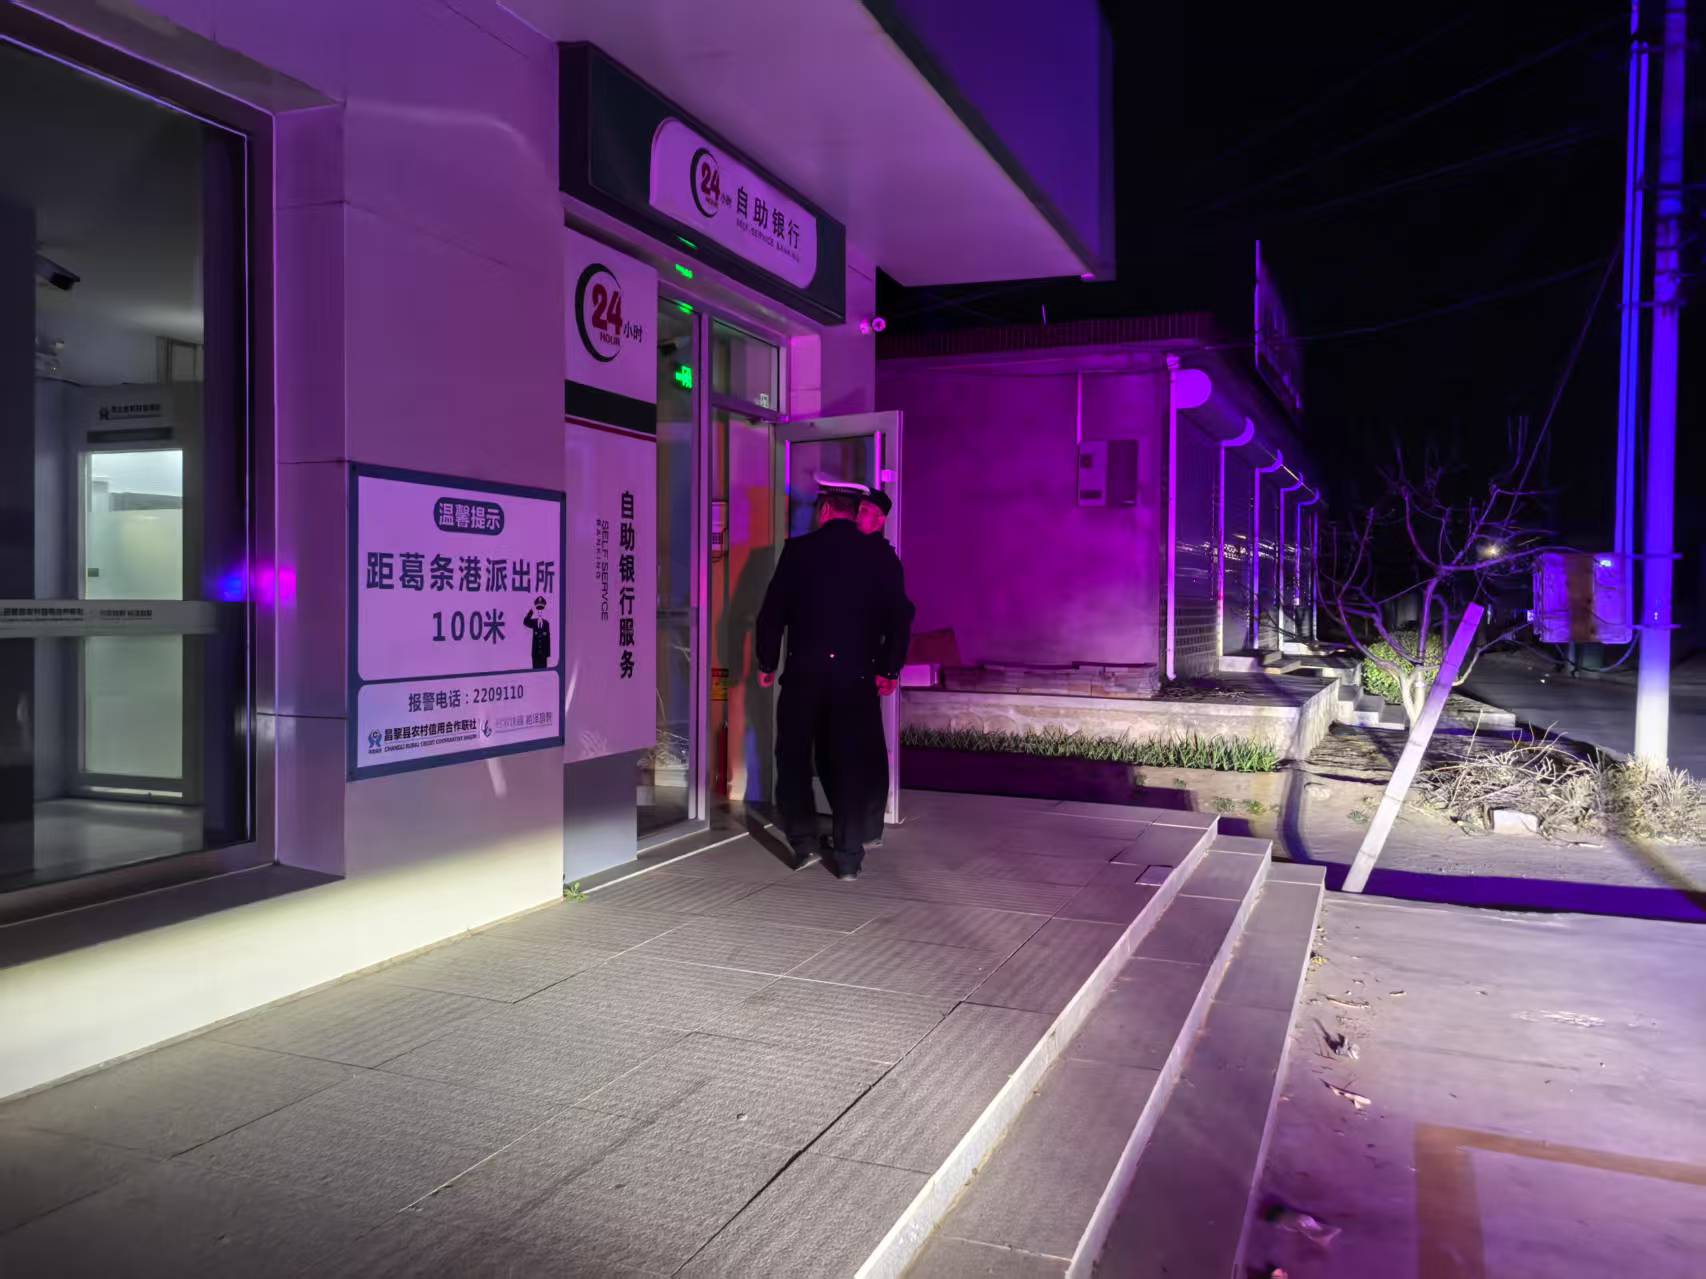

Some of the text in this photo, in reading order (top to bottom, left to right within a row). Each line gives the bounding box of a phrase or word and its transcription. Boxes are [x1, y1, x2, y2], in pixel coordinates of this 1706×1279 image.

[701, 162, 720, 201] 24
[737, 185, 800, 249] 自助银行
[591, 283, 643, 344] 24 小时
[438, 502, 501, 531] 温馨提示
[366, 551, 556, 594] 距葛条港派出所
[619, 490, 635, 679] 自助银行服务
[432, 608, 506, 645] 100米
